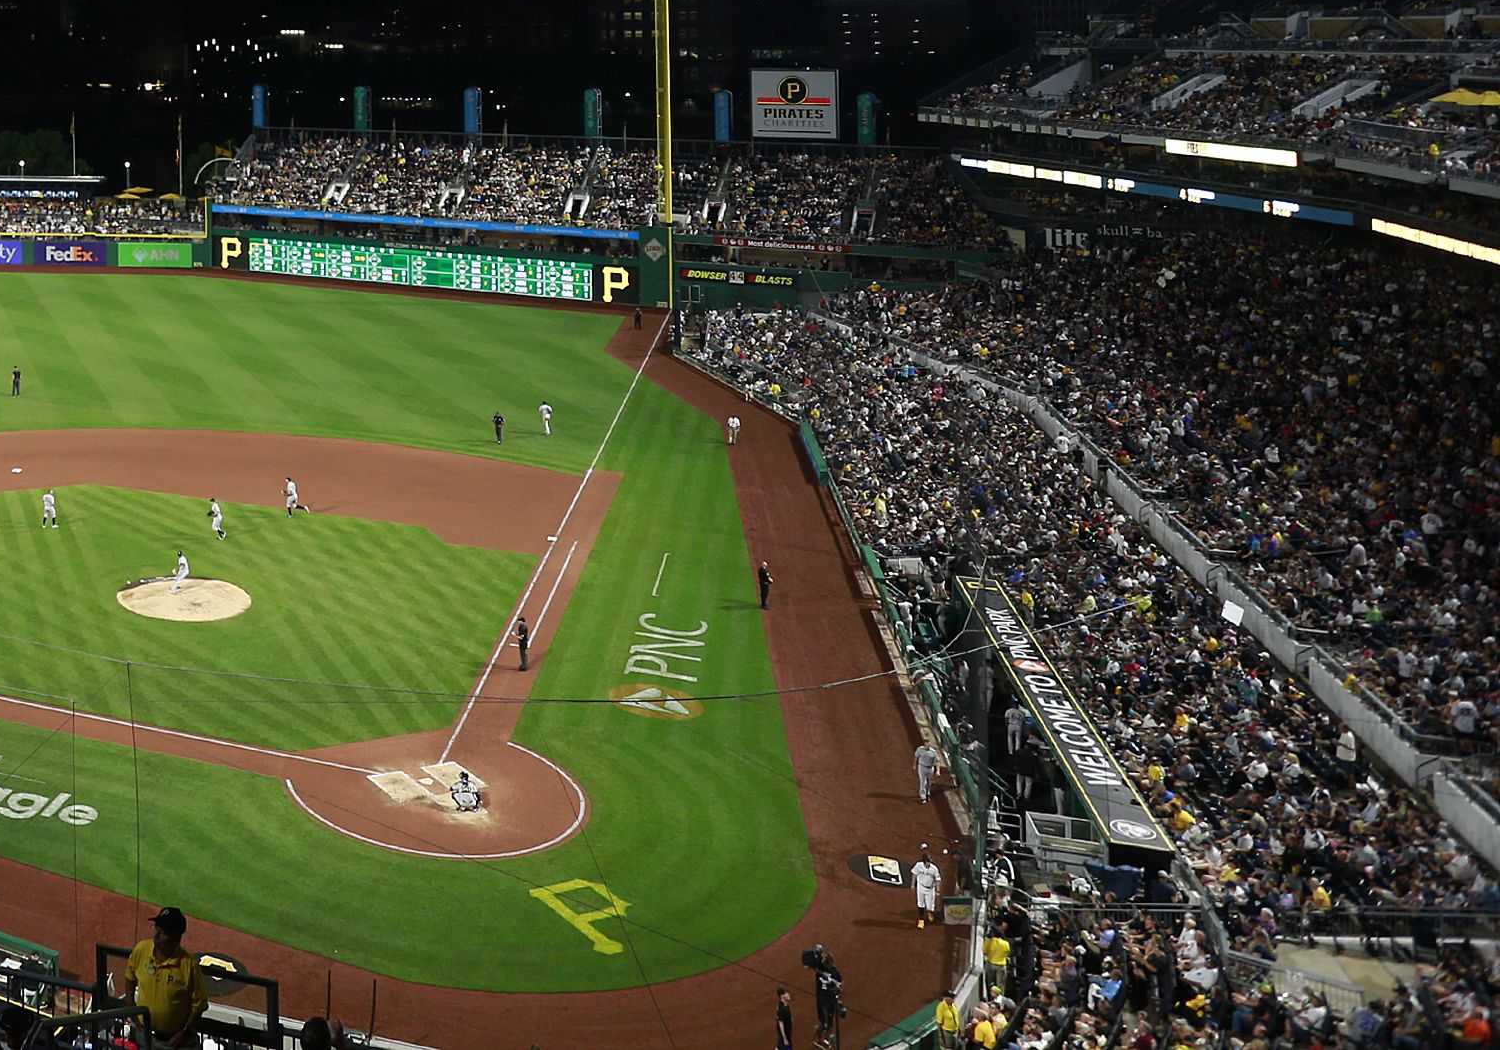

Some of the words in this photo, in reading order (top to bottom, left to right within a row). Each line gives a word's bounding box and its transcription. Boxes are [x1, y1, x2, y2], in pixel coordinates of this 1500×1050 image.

[787, 82, 800, 99] P
[763, 108, 824, 119] PIRATES
[763, 118, 825, 128] CHARITIES
[1096, 223, 1129, 236] skull
[263, 238, 330, 249] NATIONAL
[765, 241, 796, 250] delicious
[46, 245, 95, 262] FedEx
[150, 248, 180, 261] AHN
[220, 237, 242, 268] P
[426, 251, 504, 262] AMERICAN
[601, 267, 629, 303] P
[687, 269, 727, 281] BOWSER
[754, 274, 793, 286] BLASTS
[984, 606, 1021, 637] PARK
[624, 612, 708, 682] PNC
[1002, 636, 1039, 660] PNC
[1024, 675, 1065, 695] TO
[1036, 696, 1122, 786] WELCOME
[161, 908, 169, 916] P
[529, 878, 632, 955] P
[167, 974, 173, 984] P
